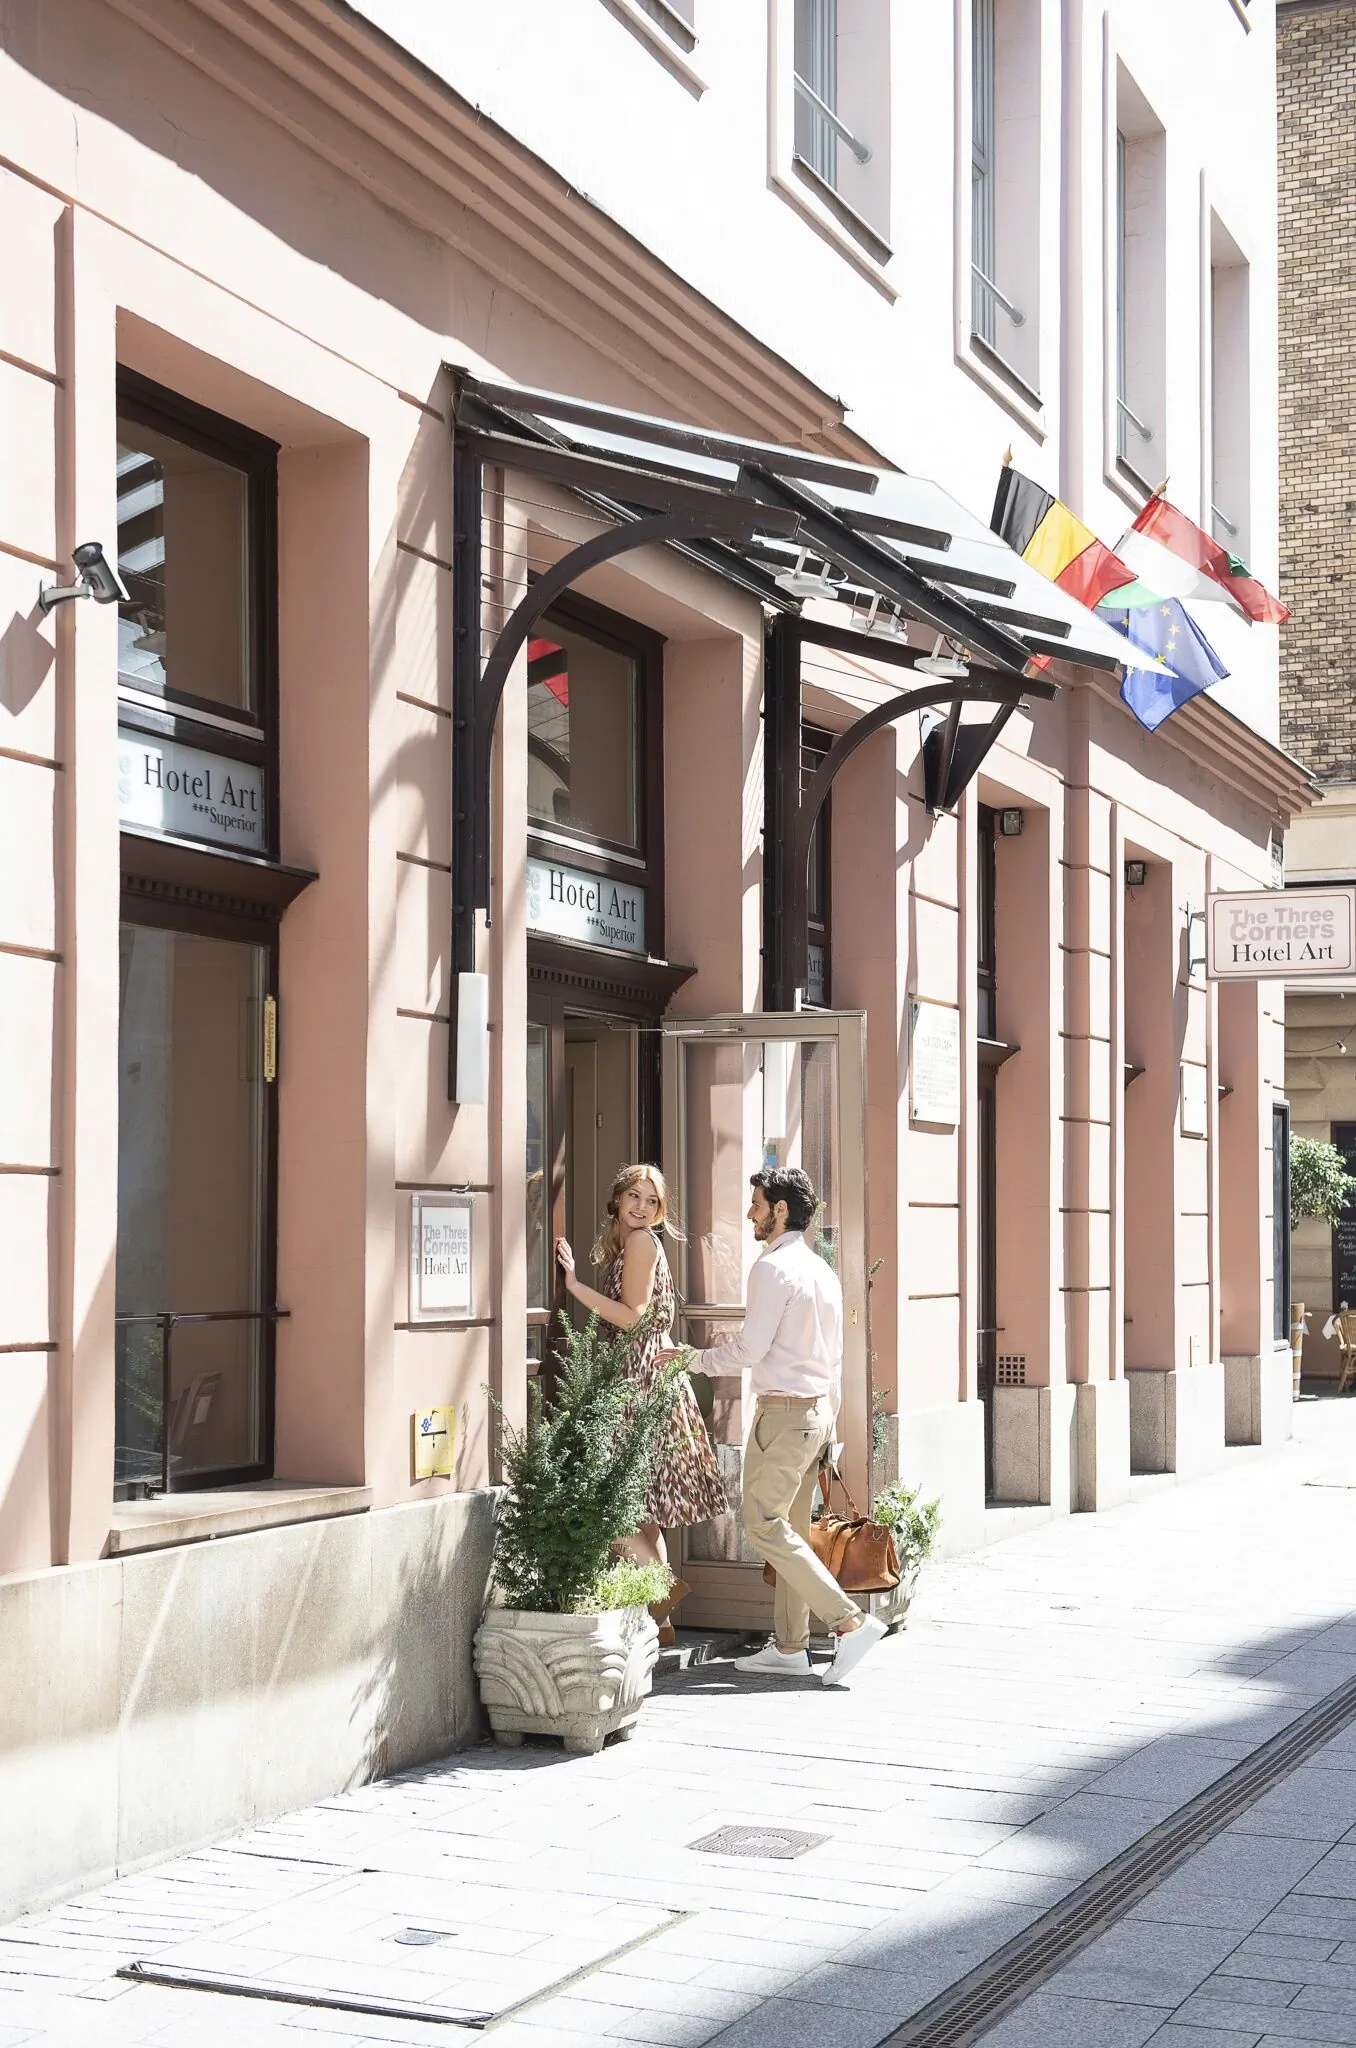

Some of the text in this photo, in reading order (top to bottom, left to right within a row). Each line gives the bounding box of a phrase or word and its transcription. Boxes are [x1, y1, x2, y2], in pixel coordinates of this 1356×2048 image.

[144, 754, 212, 800] Hotel
[220, 775, 257, 812] Art
[549, 868, 602, 913] Hotel
[608, 887, 637, 923] Art
[1229, 907, 1335, 925] The Three
[1229, 922, 1335, 941] Corners
[1232, 942, 1335, 963] Hotel Art
[423, 1224, 468, 1239] The Three
[423, 1238, 468, 1256] Corners
[424, 1257, 467, 1275] Hotel Art
